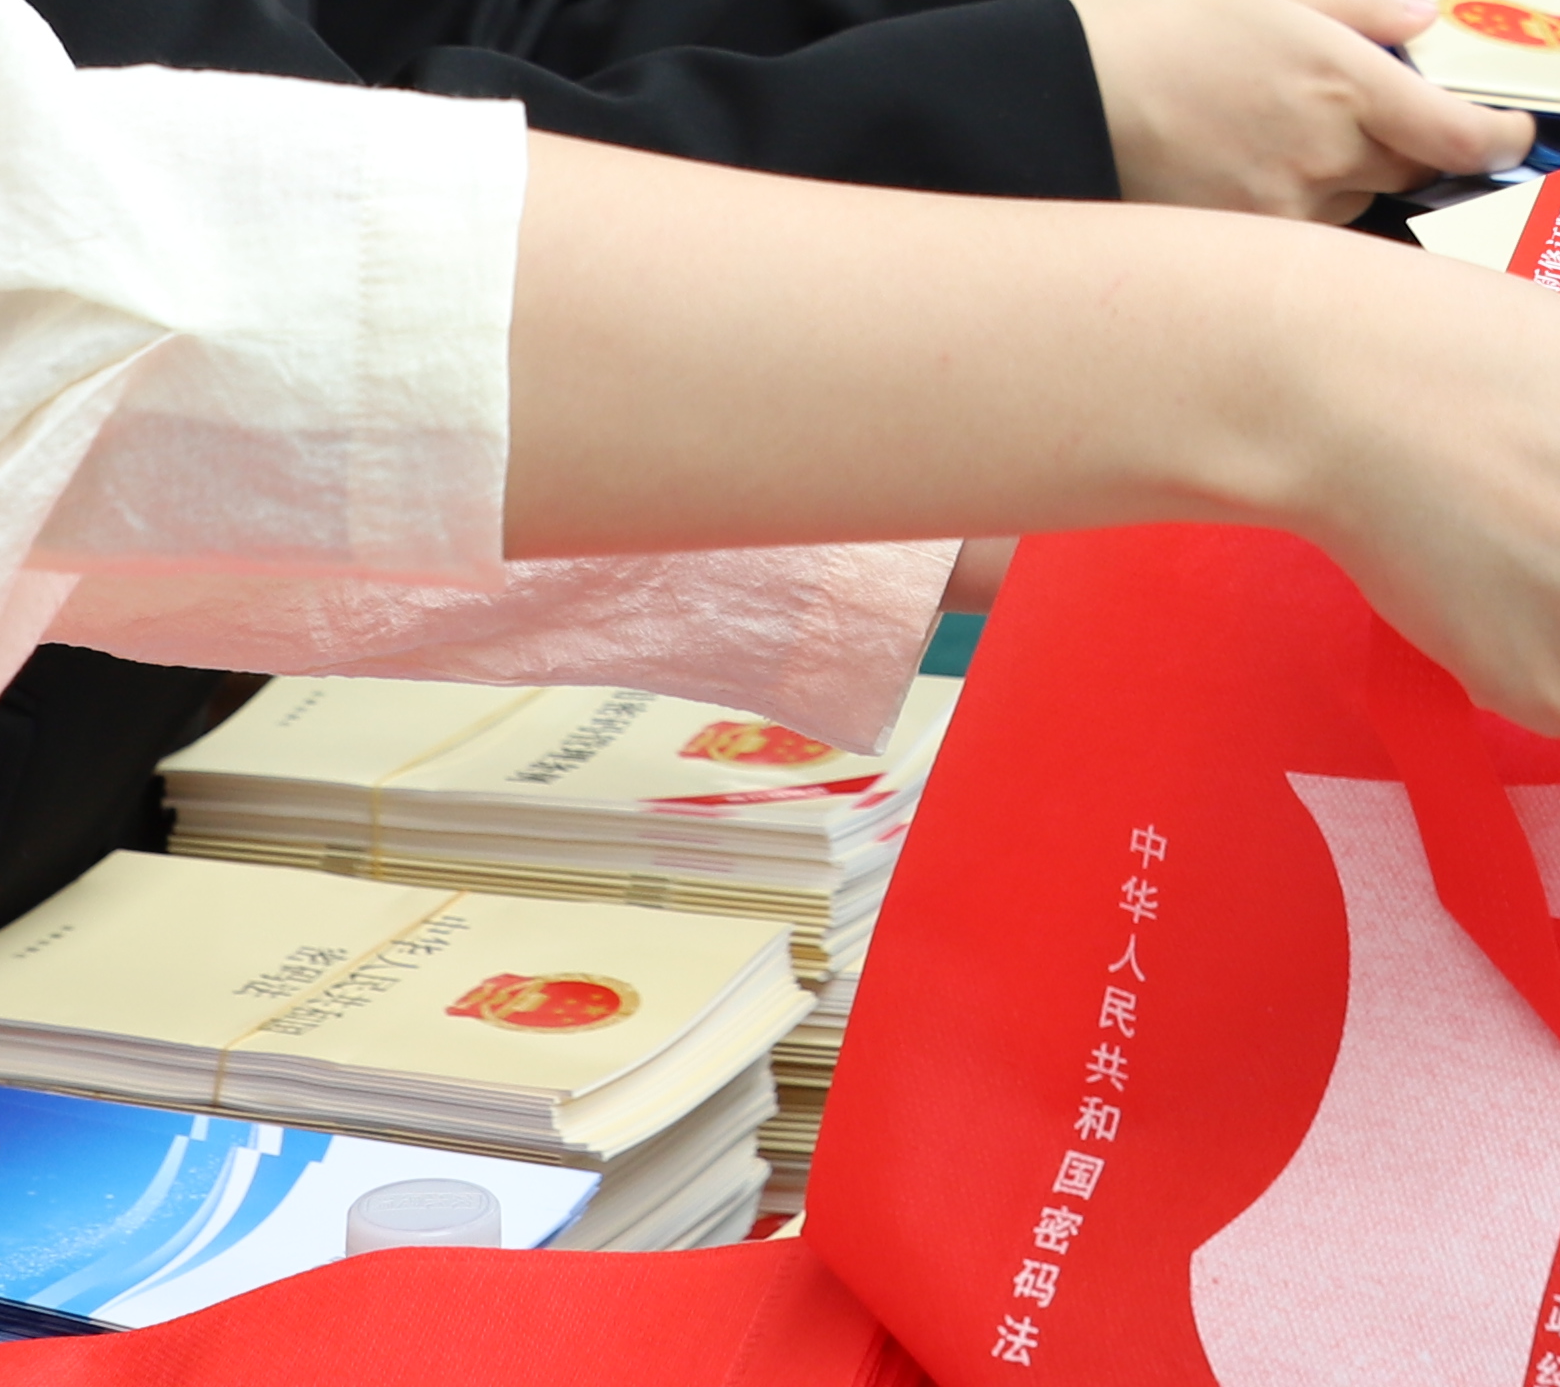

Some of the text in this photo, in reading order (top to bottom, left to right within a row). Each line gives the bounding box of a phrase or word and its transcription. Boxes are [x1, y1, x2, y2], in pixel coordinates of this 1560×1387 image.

[991, 824, 1168, 1367] 中华人民共和国密码法
